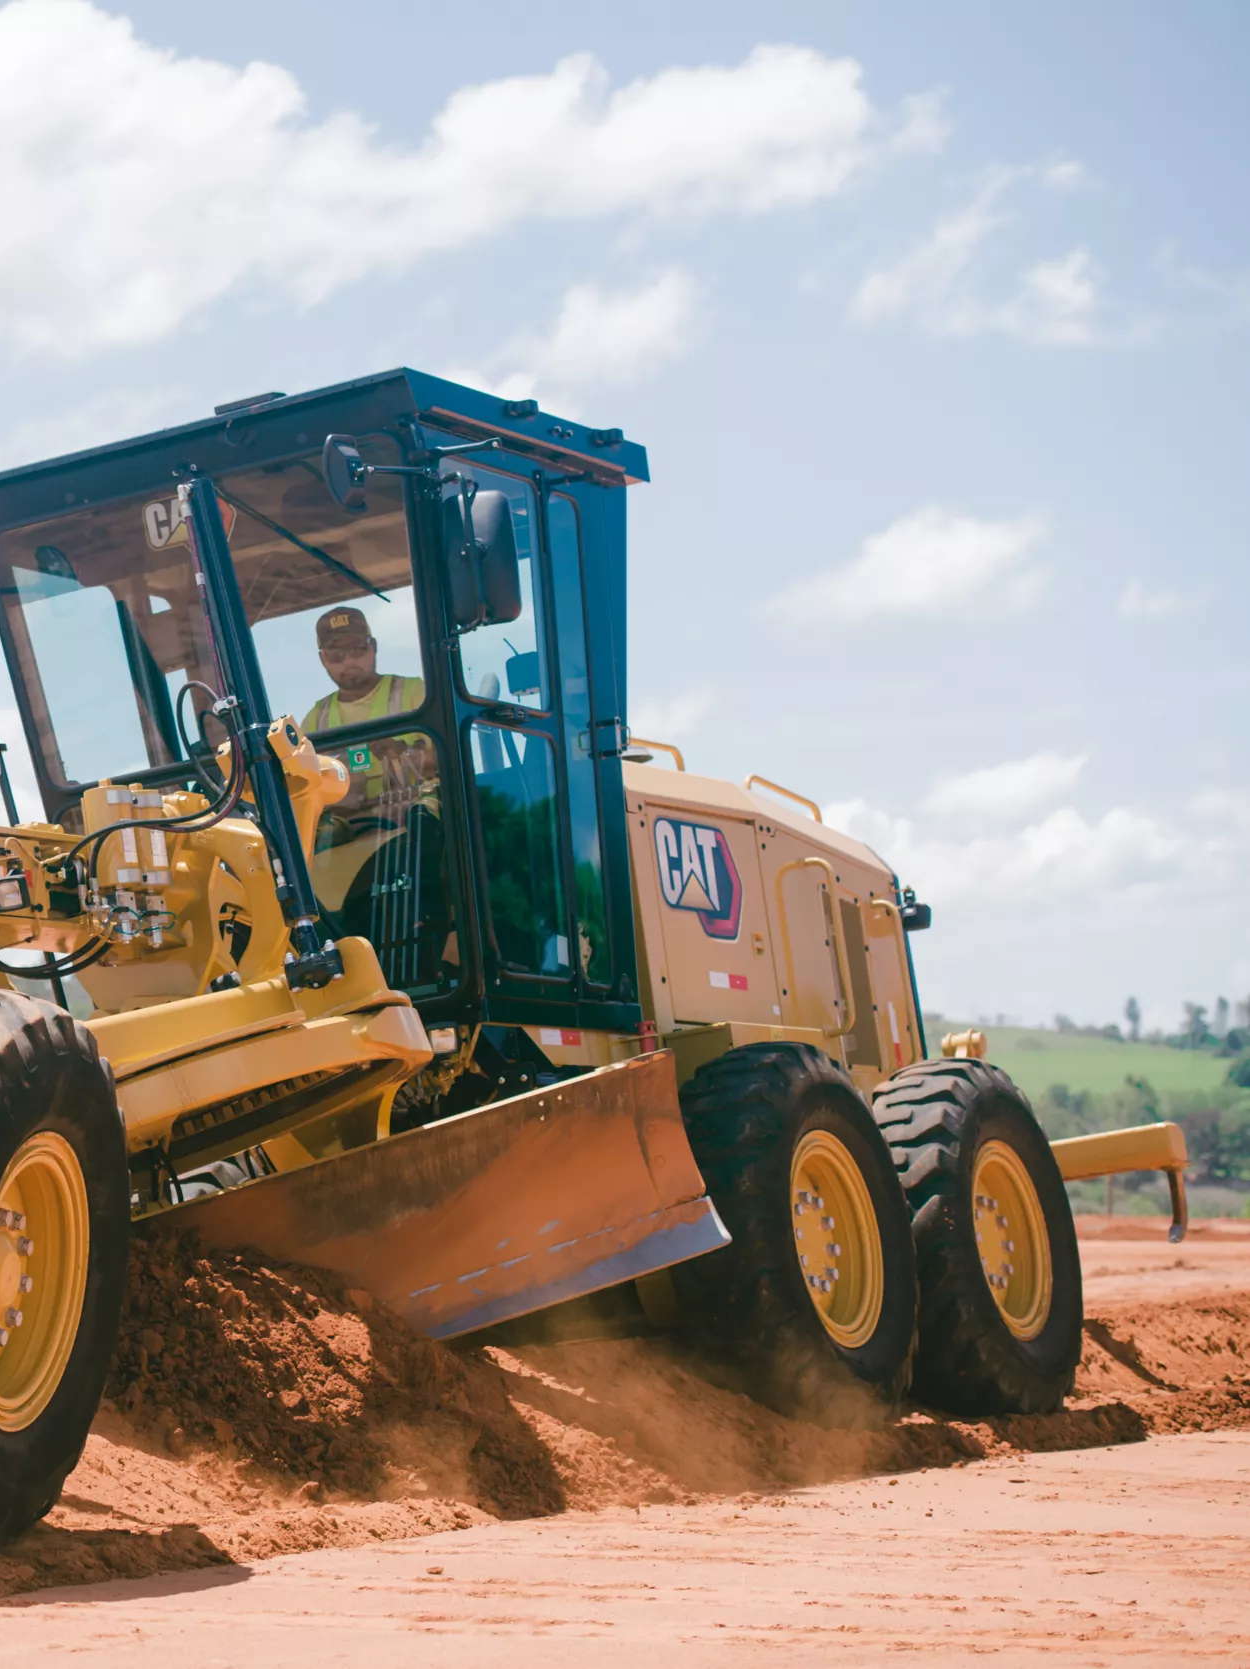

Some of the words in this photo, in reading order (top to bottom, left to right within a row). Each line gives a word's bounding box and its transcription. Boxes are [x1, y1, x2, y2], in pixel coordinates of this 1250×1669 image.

[145, 498, 188, 547] CA
[330, 614, 349, 628] CAT
[655, 820, 720, 911] CAT
